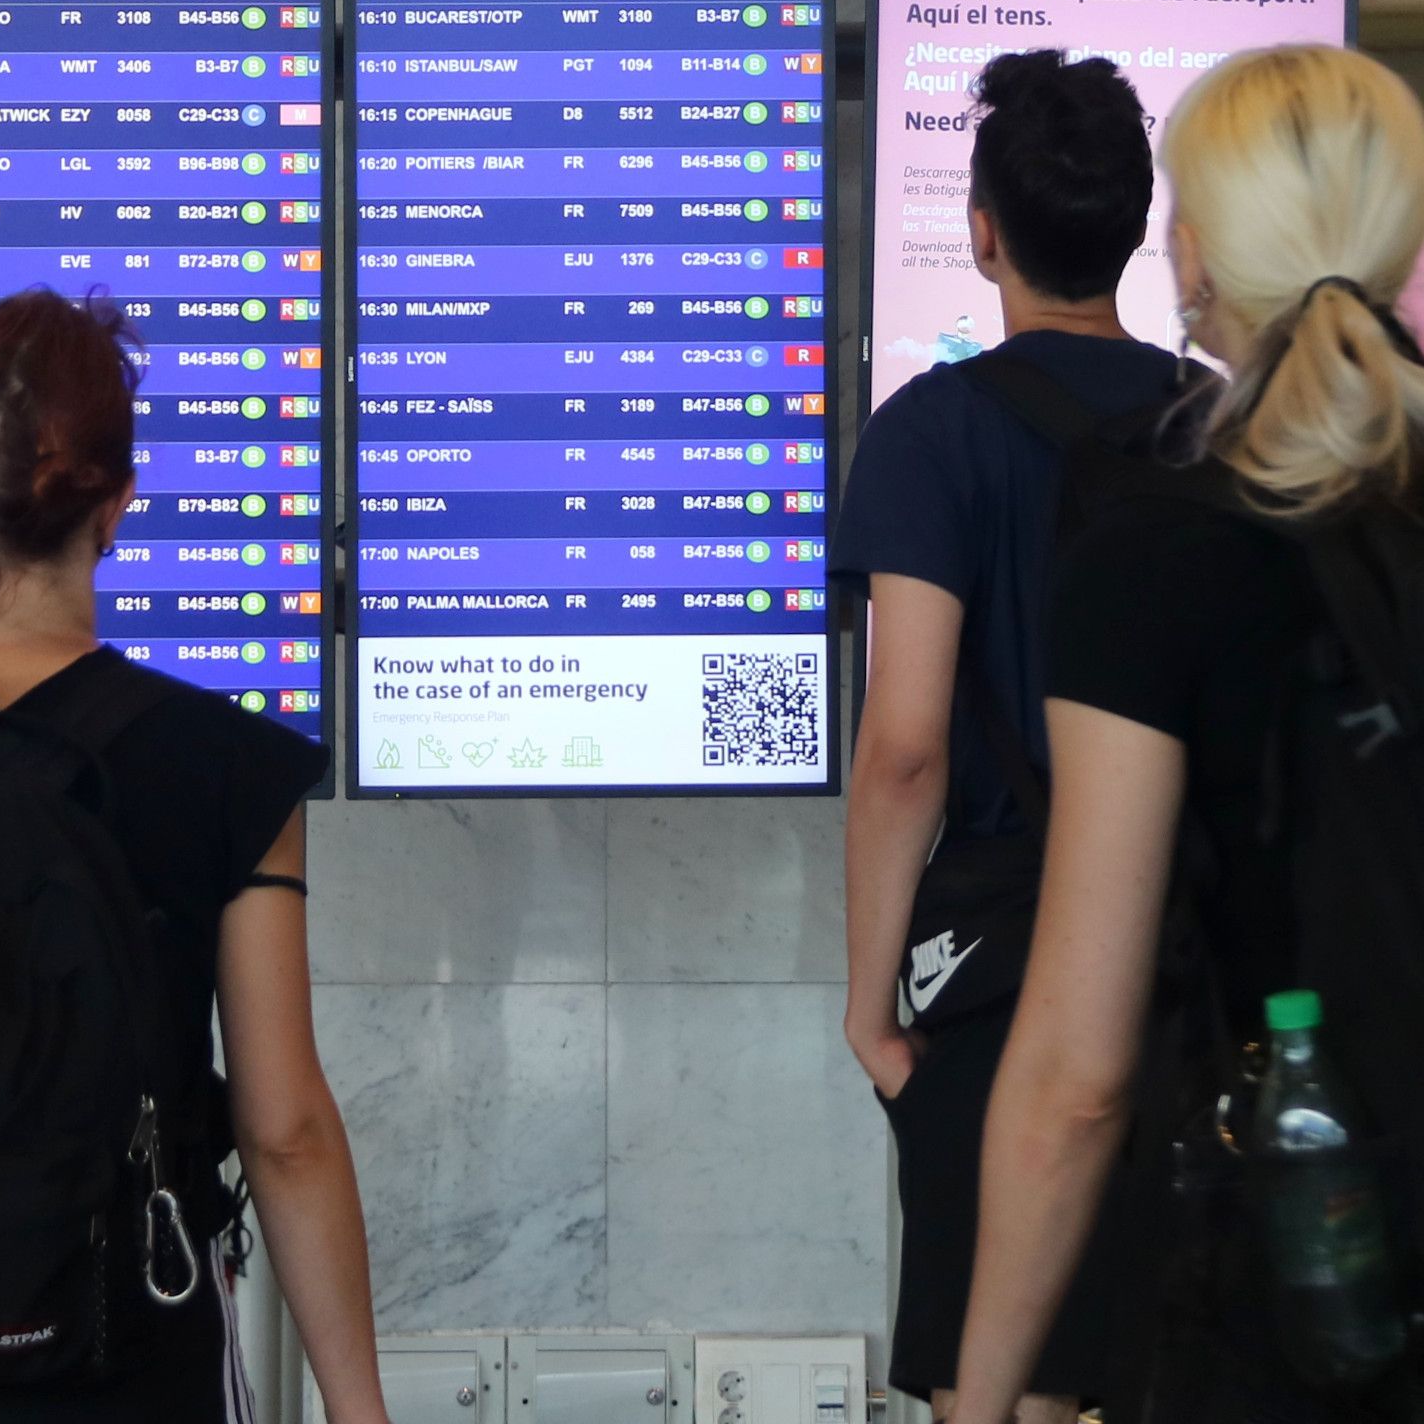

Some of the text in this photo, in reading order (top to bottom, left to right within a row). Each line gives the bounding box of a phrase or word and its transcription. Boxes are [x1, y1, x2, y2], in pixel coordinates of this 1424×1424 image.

[907, 4, 1051, 28] Aquí el tens.
[905, 43, 1026, 67] ¿Necesi
[1140, 47, 1174, 67] del
[904, 70, 956, 95] Aquí
[61, 109, 90, 121] EZY
[117, 109, 151, 121] 8058
[179, 109, 239, 121] C29-C33
[294, 109, 307, 121] M
[905, 111, 966, 132] Need
[904, 183, 970, 198] les Botigue
[903, 220, 920, 233] las
[903, 240, 962, 253] Download
[360, 255, 397, 267] 16:30
[406, 254, 475, 267] GINEBRA
[565, 253, 593, 266] EJU
[621, 253, 654, 265] 1376
[682, 253, 741, 265] C29-C33
[798, 253, 808, 265] R
[902, 256, 918, 268] all
[922, 256, 941, 268] the
[375, 655, 579, 673] Know what to do in
[374, 681, 647, 702] the case of an emergency
[373, 711, 510, 725] Emergency Response Plan
[911, 929, 956, 982] NIKE
